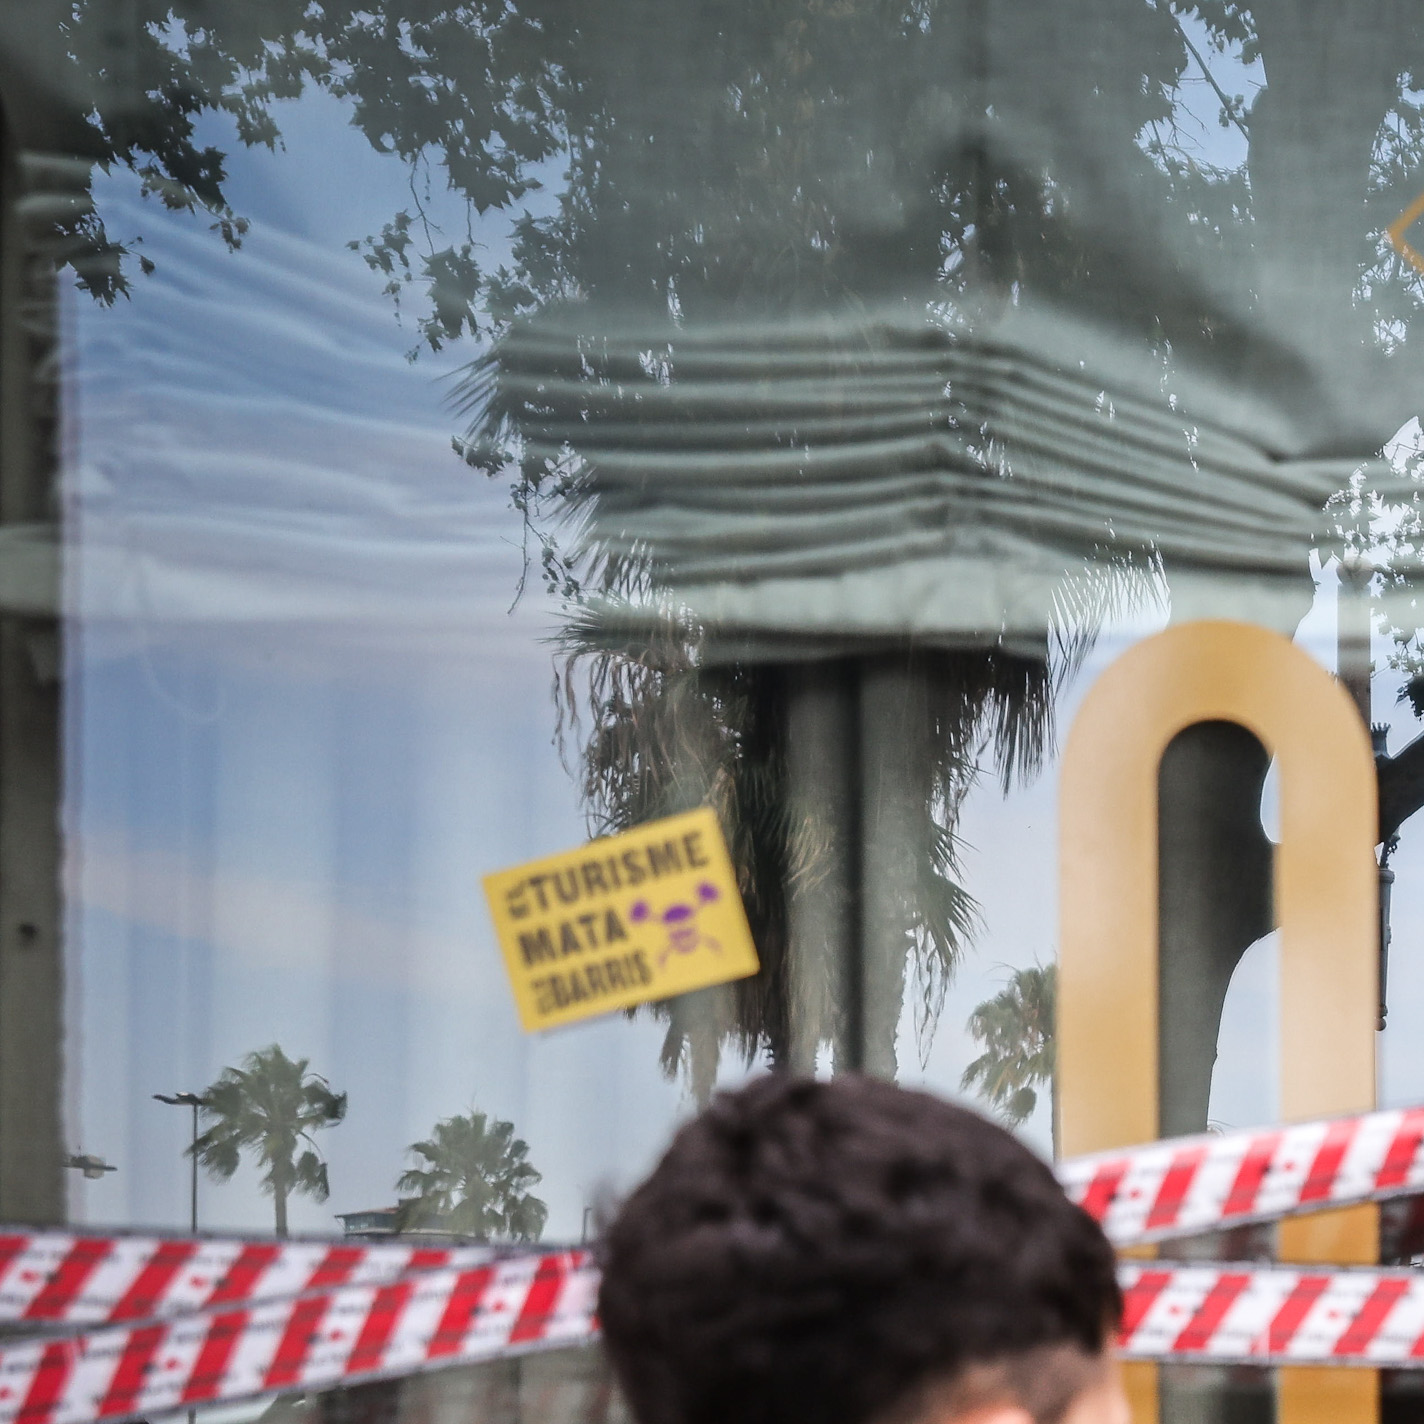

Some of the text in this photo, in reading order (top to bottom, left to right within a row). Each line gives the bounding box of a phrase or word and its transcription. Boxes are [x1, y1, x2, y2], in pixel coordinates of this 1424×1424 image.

[530, 831, 708, 909] TURISME
[519, 909, 627, 966] MATA
[549, 950, 652, 1008] BARRIS
